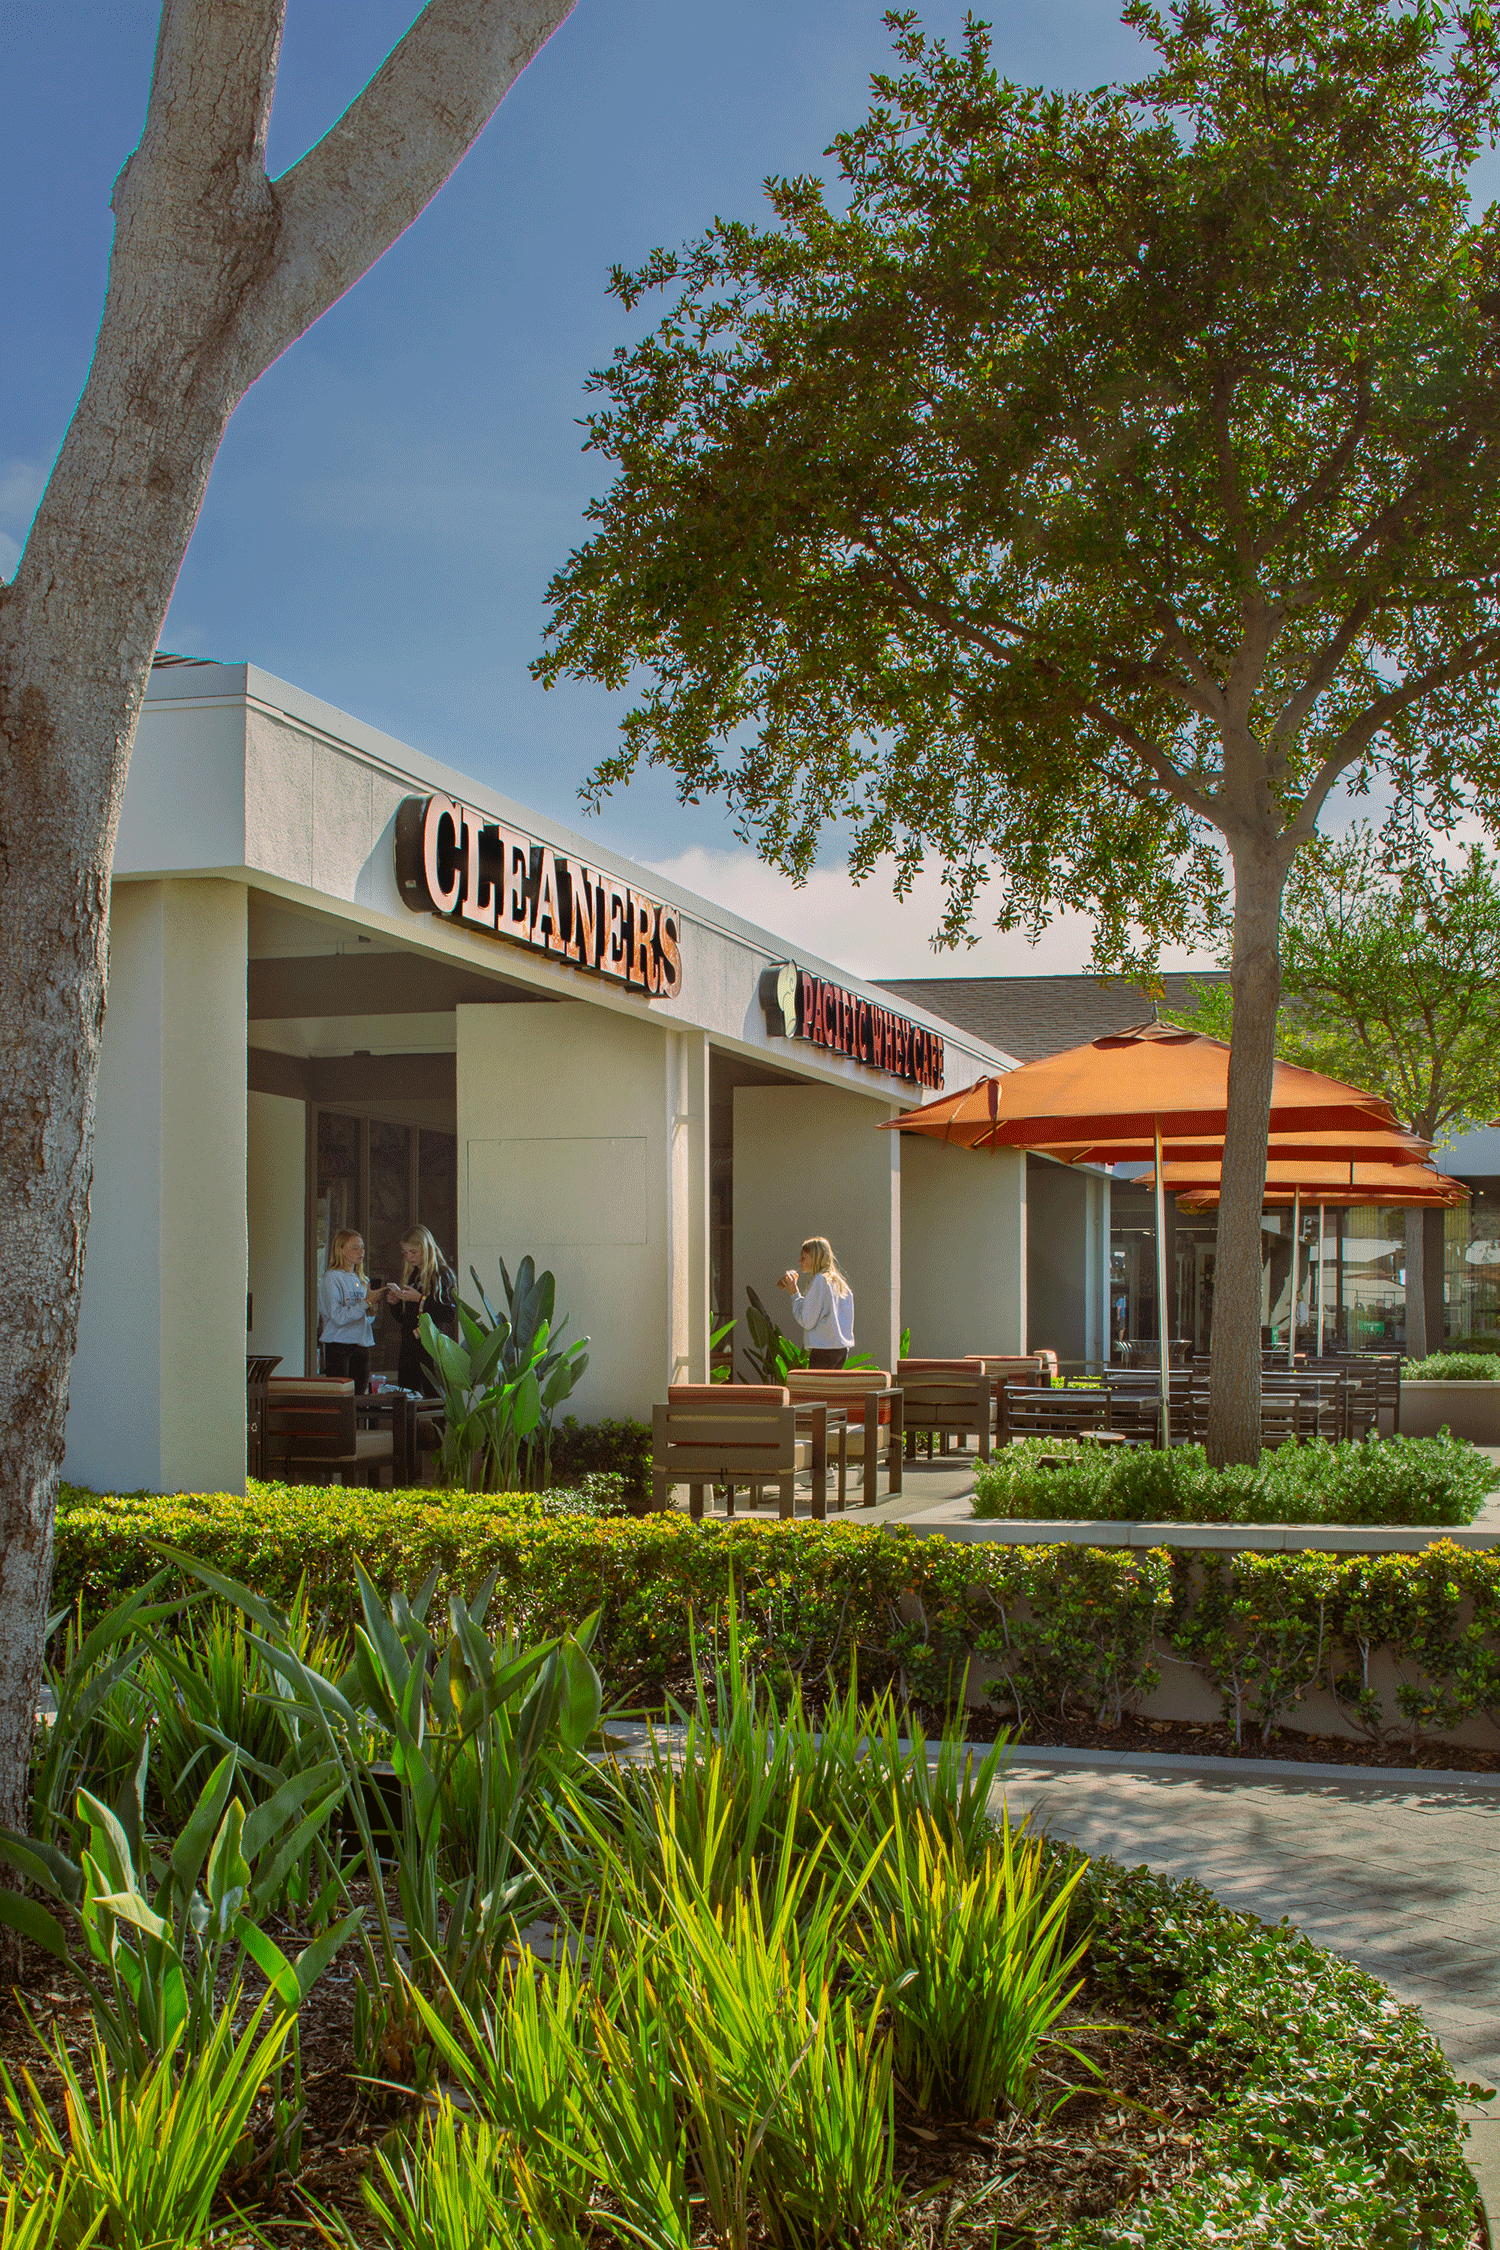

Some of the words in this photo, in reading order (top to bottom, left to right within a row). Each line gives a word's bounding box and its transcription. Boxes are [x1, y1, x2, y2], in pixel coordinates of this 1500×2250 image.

[423, 793, 682, 999] CLEANERS
[802, 970, 869, 1061] PACIFIC
[871, 1004, 911, 1078] WHEY
[913, 1026, 944, 1091] CAFE
